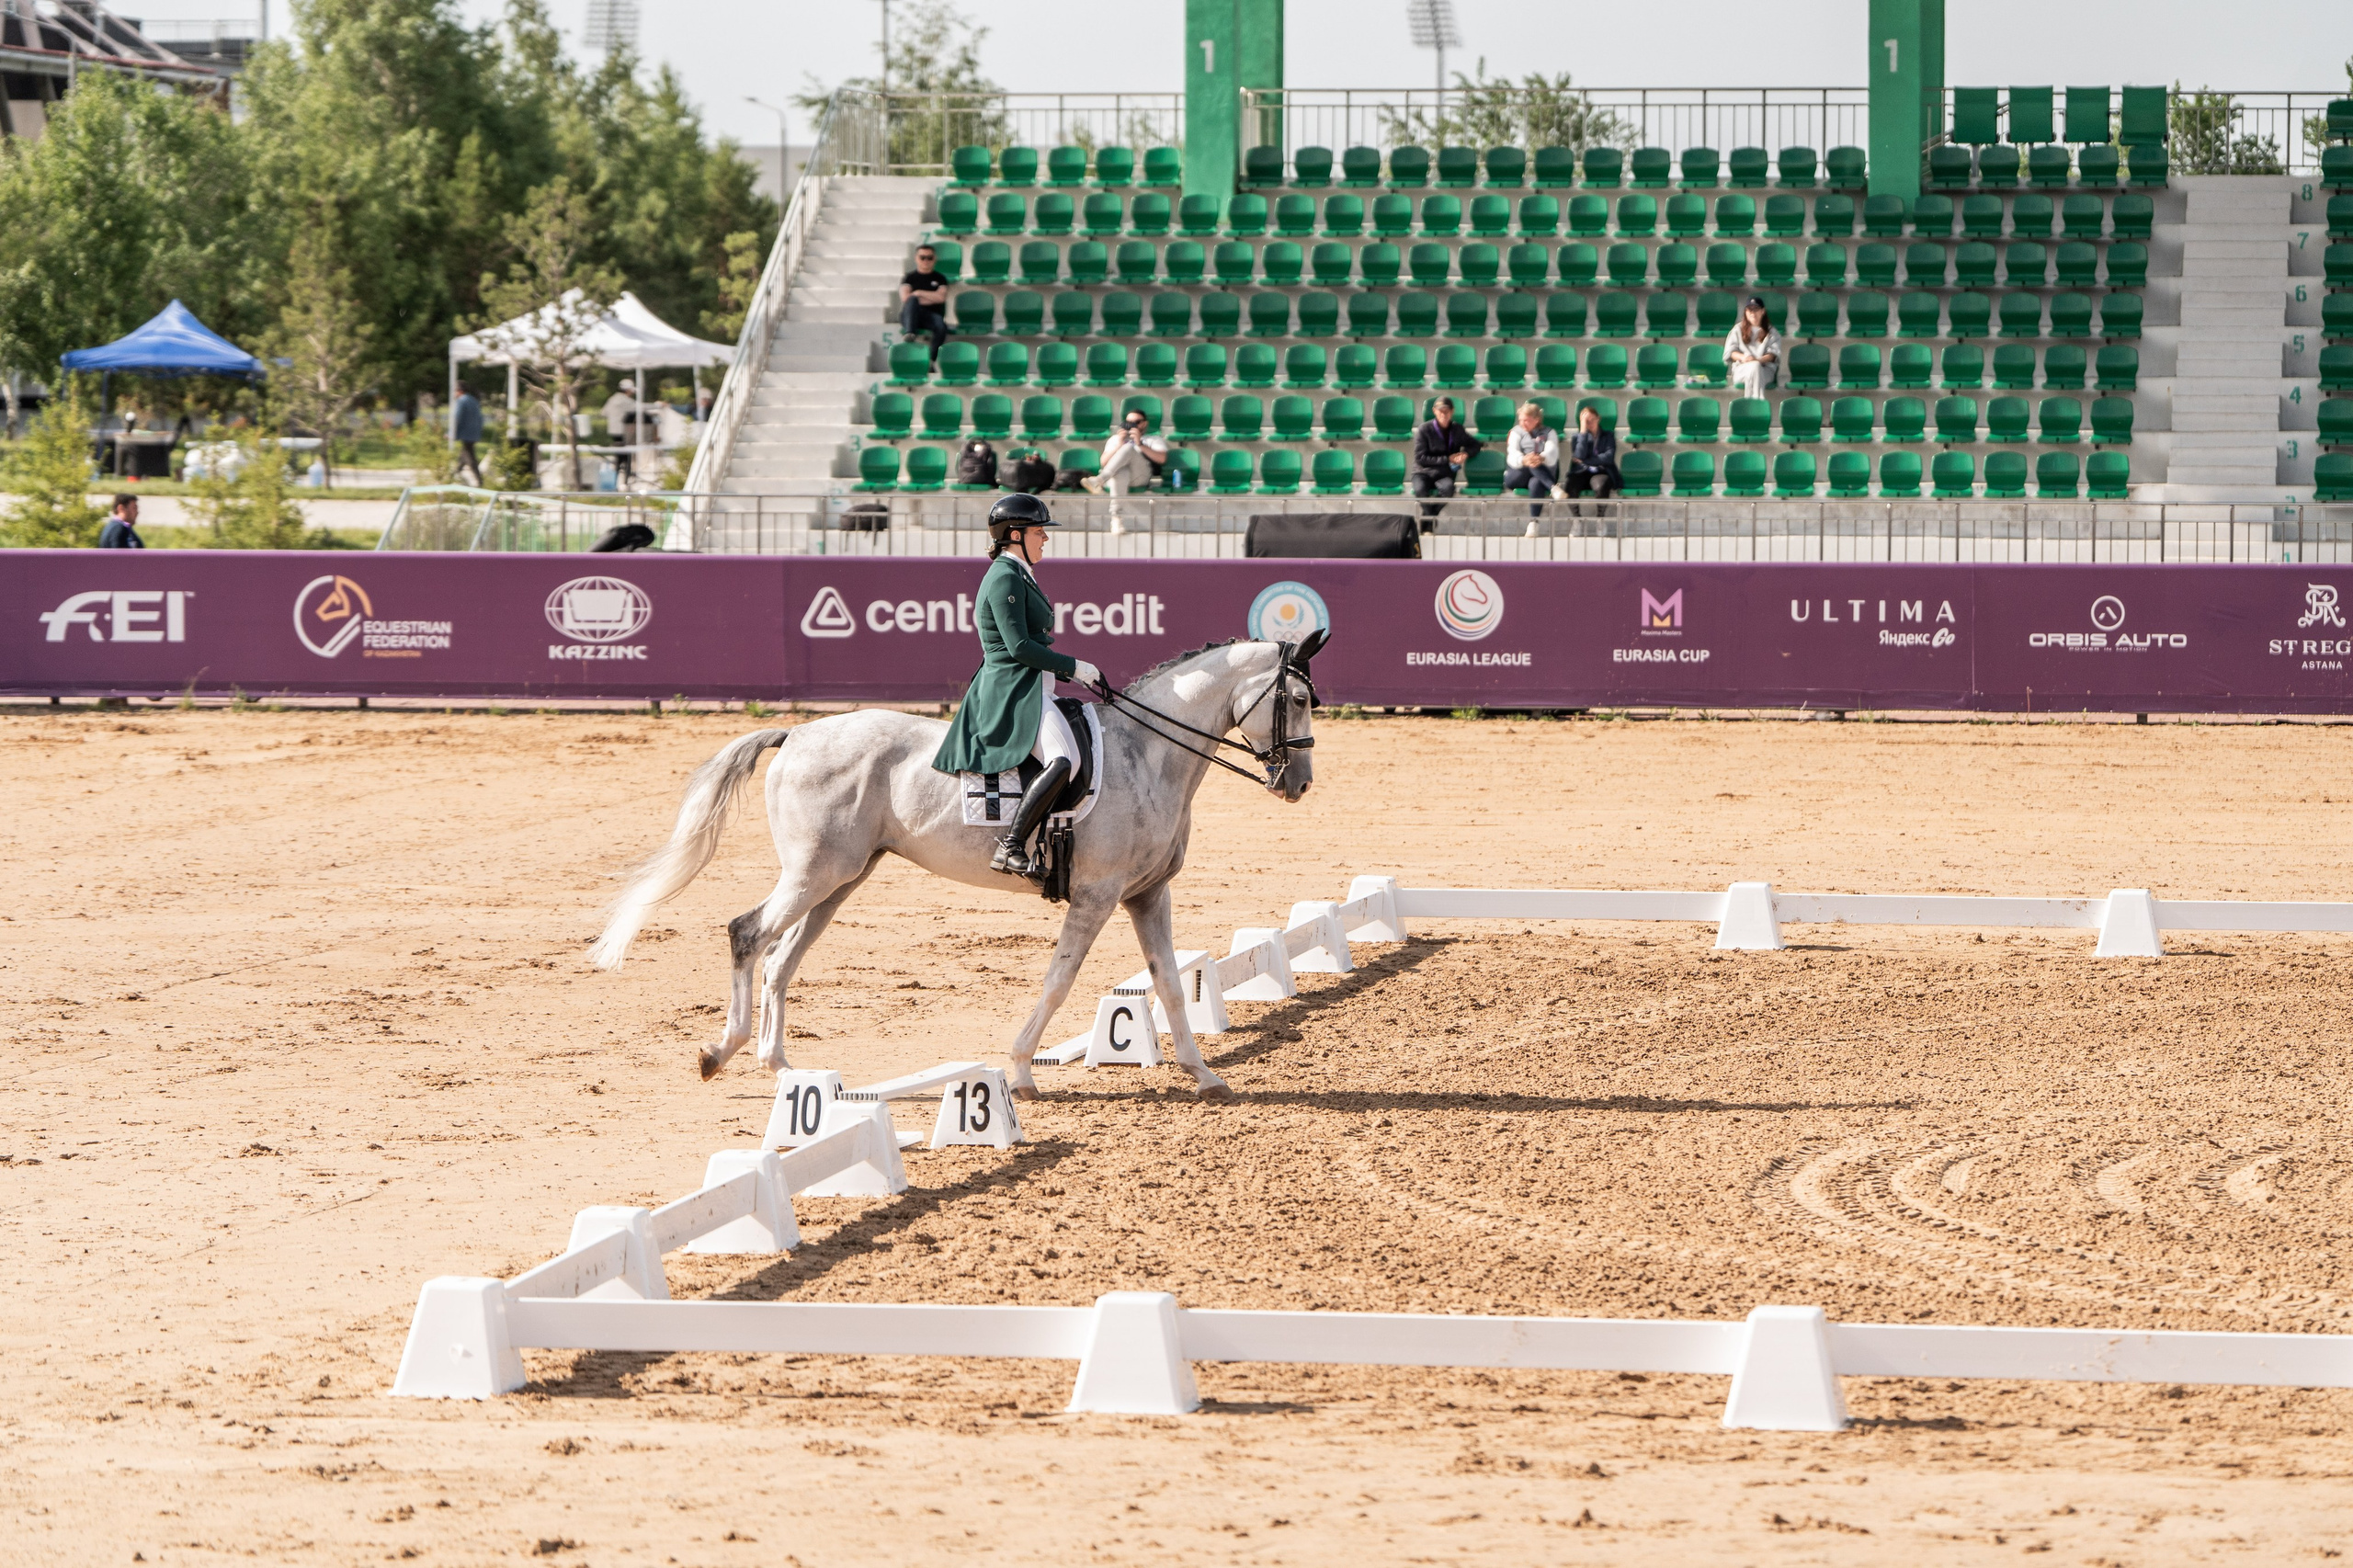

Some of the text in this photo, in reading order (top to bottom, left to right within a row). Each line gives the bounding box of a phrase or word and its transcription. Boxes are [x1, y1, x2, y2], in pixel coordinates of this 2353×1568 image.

[1199, 40, 1214, 73] 1
[1884, 39, 1898, 73] 1
[2302, 183, 2313, 201] 8
[2297, 232, 2310, 249] 7
[2295, 284, 2307, 302] 6
[882, 332, 893, 349] 5
[2292, 334, 2305, 353] 5
[2289, 385, 2302, 404] 4
[849, 434, 862, 452] 3
[2286, 439, 2298, 459] 3
[39, 590, 186, 642] FEI
[1790, 598, 1956, 623] ULTIMA
[362, 620, 453, 634] EQUESTRIAN
[362, 634, 450, 648] FEDERATION
[1879, 627, 1956, 648] Яндекс Go
[2029, 632, 2188, 648] ORBIS AUTO
[548, 644, 648, 660] KAZZINC
[1613, 649, 1711, 663] EURASIA CUP
[2268, 639, 2299, 656] ST
[1406, 652, 1532, 666] EURASIA LEAGUE
[2301, 660, 2344, 671] ASTANA
[1108, 1006, 1134, 1052] C
[785, 1084, 822, 1136] 10
[953, 1081, 991, 1132] 13
